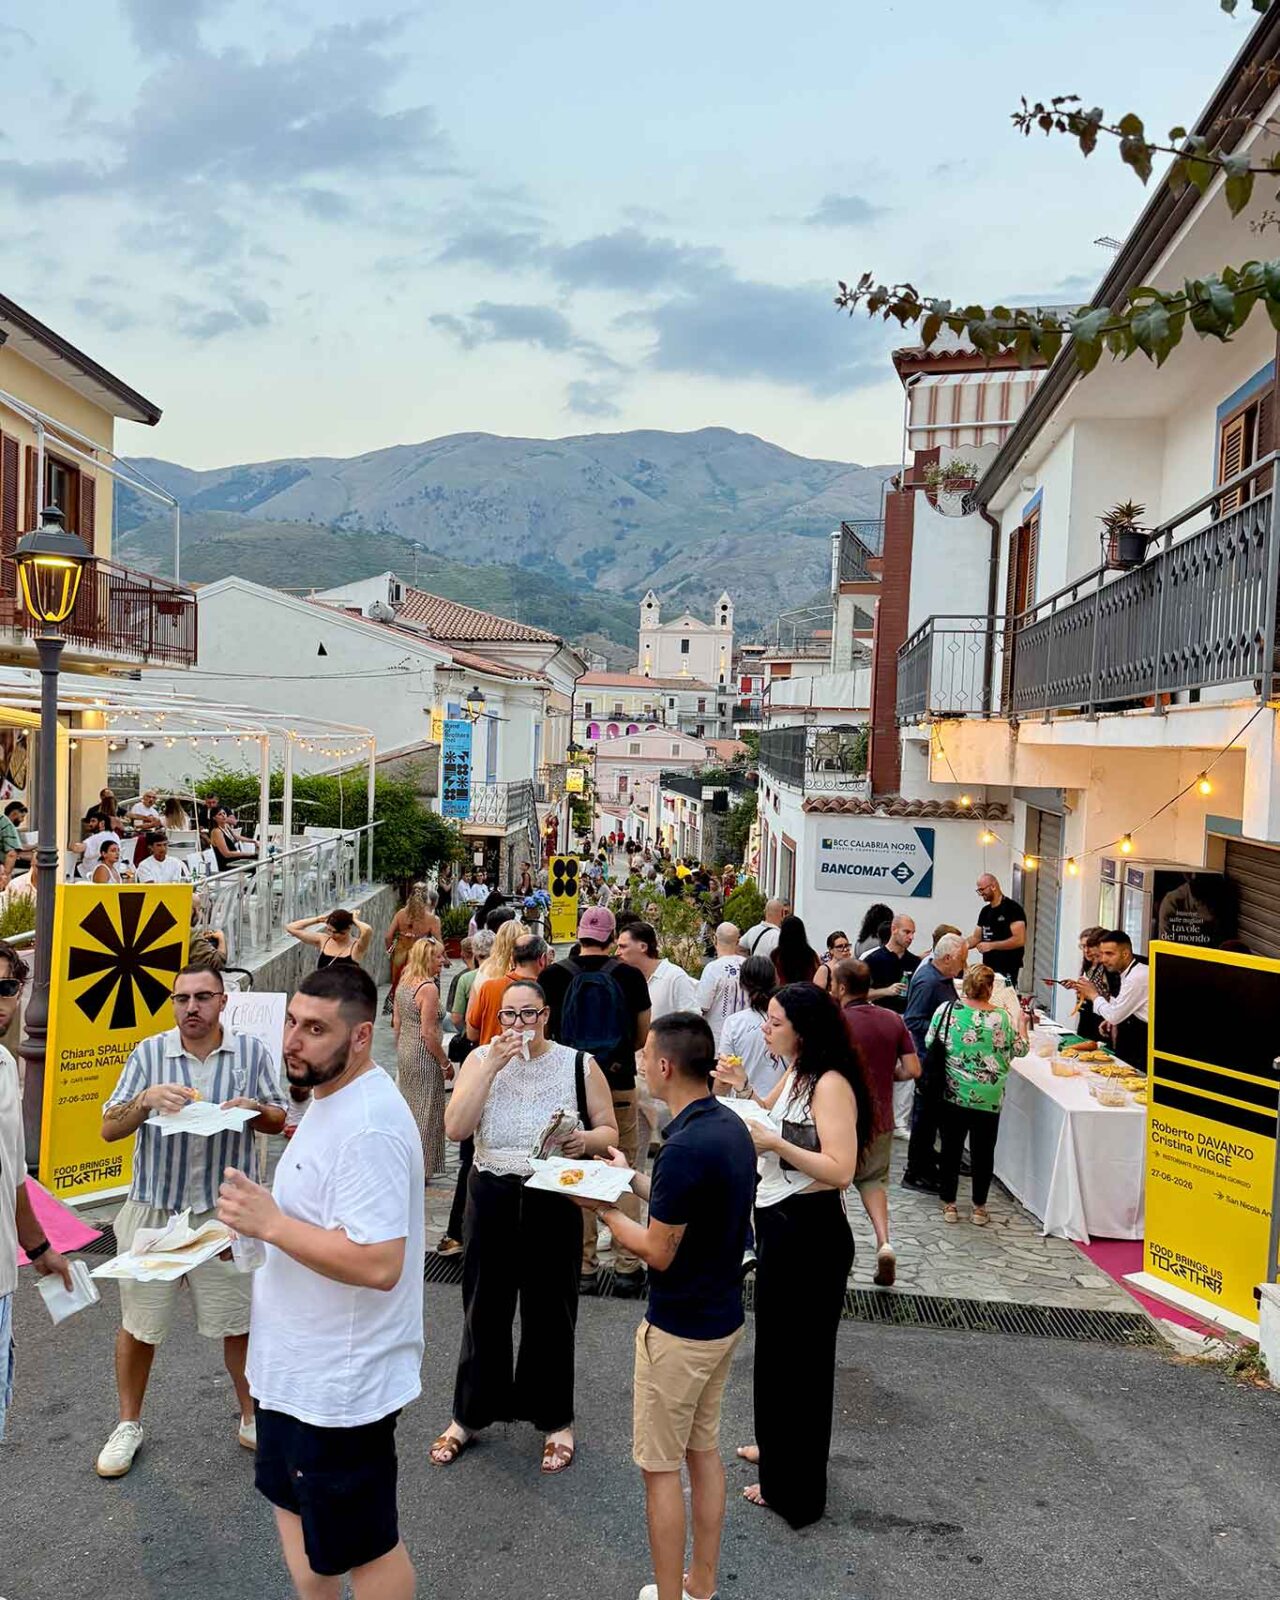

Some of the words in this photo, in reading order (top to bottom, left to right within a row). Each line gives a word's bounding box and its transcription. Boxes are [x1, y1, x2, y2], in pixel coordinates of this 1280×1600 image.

[833, 839, 849, 847] BCC
[850, 840, 889, 849] CALABRIA
[891, 843, 916, 851] NORD
[821, 862, 890, 877] BANCOMAT
[1161, 931, 1175, 940] del
[1177, 934, 1210, 943] mondo
[1172, 924, 1200, 933] tavole
[60, 1060, 93, 1072] Marco
[95, 1053, 129, 1067] NATAL
[61, 1047, 95, 1060] Chiara
[58, 1092, 99, 1105] 27-06-2026
[1151, 1131, 1193, 1155] Cristina
[1152, 1118, 1195, 1142] Roberto
[1197, 1133, 1254, 1161] DAVANZO
[53, 1165, 78, 1176] FOOD
[79, 1158, 110, 1171] BRINGS
[112, 1155, 123, 1164] US
[53, 1164, 122, 1190] TOGETHER
[1151, 1168, 1193, 1191] 27-06-2026
[1225, 1195, 1240, 1207] San
[1240, 1200, 1261, 1214] Nicola
[1149, 1241, 1174, 1259] FOOD
[1175, 1253, 1209, 1274] BRINGS
[1210, 1267, 1223, 1281] US
[1149, 1251, 1223, 1295] TOGETHER
